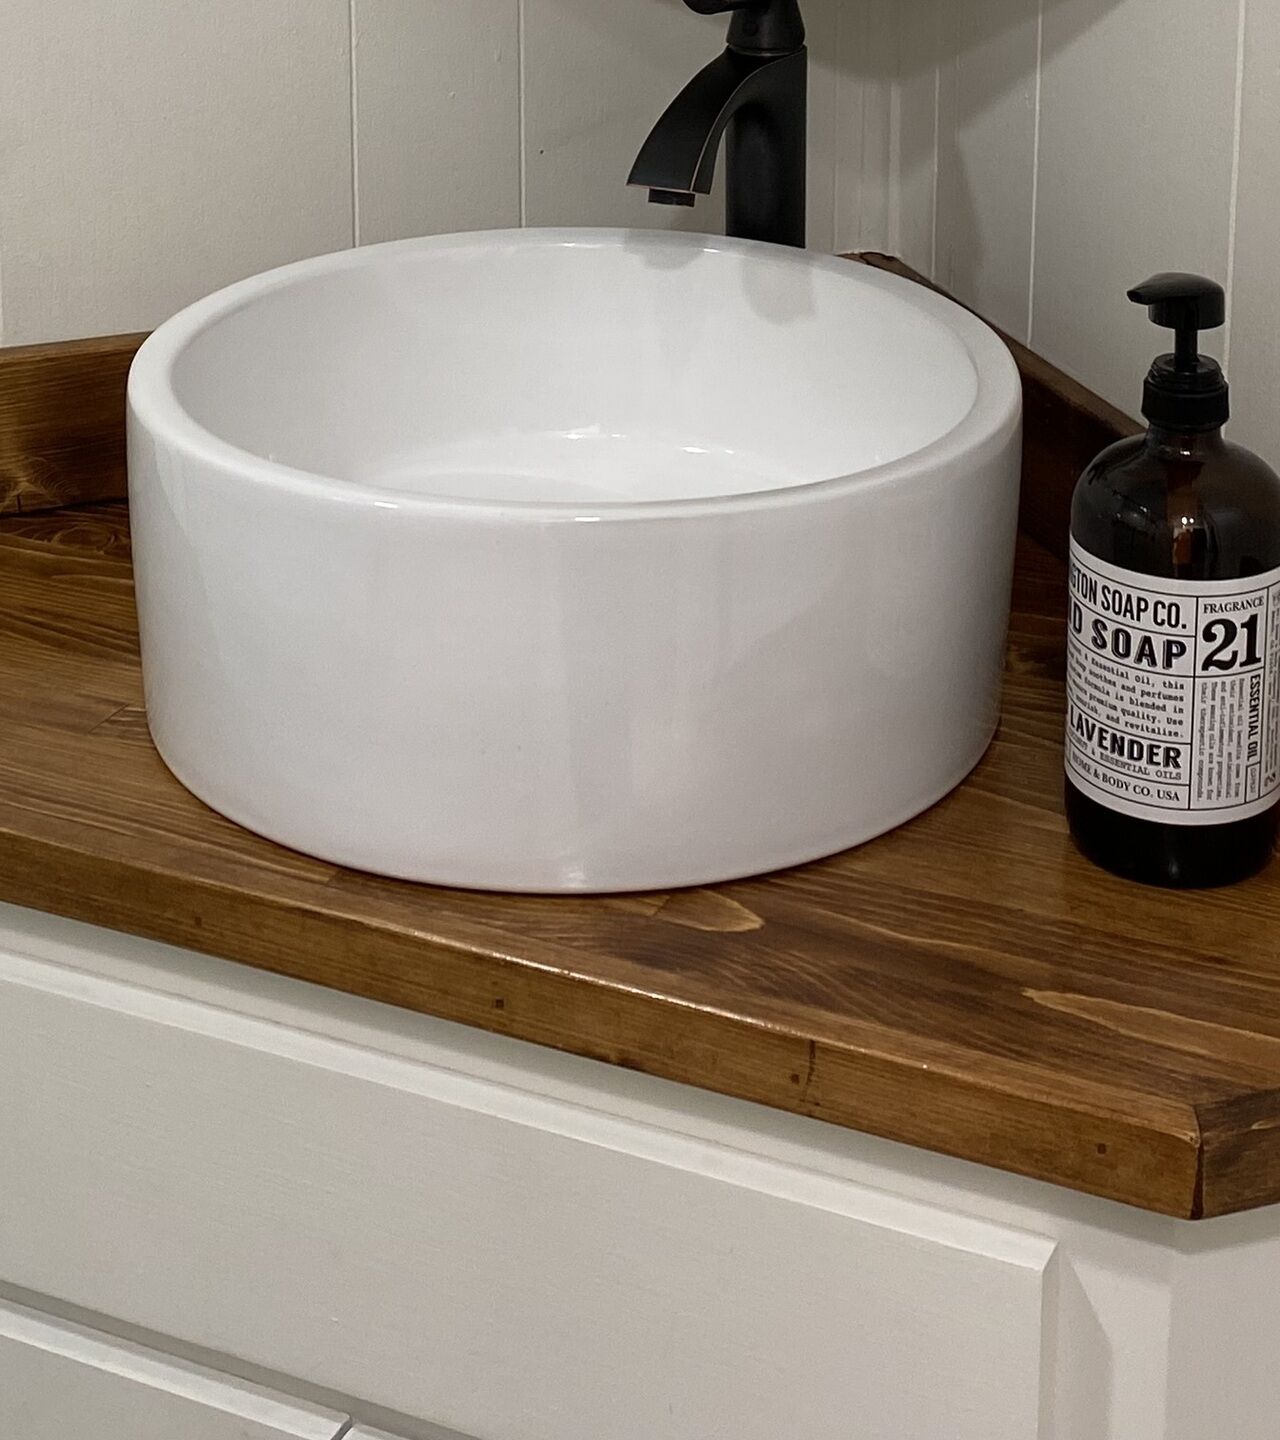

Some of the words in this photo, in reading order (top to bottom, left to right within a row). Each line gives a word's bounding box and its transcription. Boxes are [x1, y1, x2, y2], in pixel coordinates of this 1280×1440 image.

[1101, 585, 1149, 623] SOAP
[1152, 600, 1187, 629] CO.
[1203, 596, 1265, 614] FRAGRANCE
[1091, 618, 1187, 670] SOAP
[1201, 613, 1263, 672] 21
[1091, 657, 1130, 680] Essential
[1163, 680, 1185, 690] this
[1089, 693, 1118, 712] premium
[1121, 708, 1161, 724] quality.
[1166, 717, 1184, 726] Use
[1115, 692, 1124, 702] is
[1129, 696, 1167, 712] blended
[1174, 705, 1184, 714] in
[1121, 684, 1136, 694] and
[1141, 689, 1184, 702] perfumes
[1249, 674, 1261, 739] ESSENTIAL
[1070, 704, 1182, 770] LAVENDER
[1106, 714, 1120, 724] and
[1125, 720, 1184, 738] revitalize.
[1100, 752, 1150, 776] ESSENTIAL
[1155, 770, 1182, 780] OILS
[1248, 742, 1259, 761] OIL
[1072, 751, 1092, 775] HOME
[1094, 768, 1100, 780] &
[1102, 773, 1131, 792] BODY
[1133, 784, 1154, 798] CO.
[1157, 789, 1180, 802] USA
